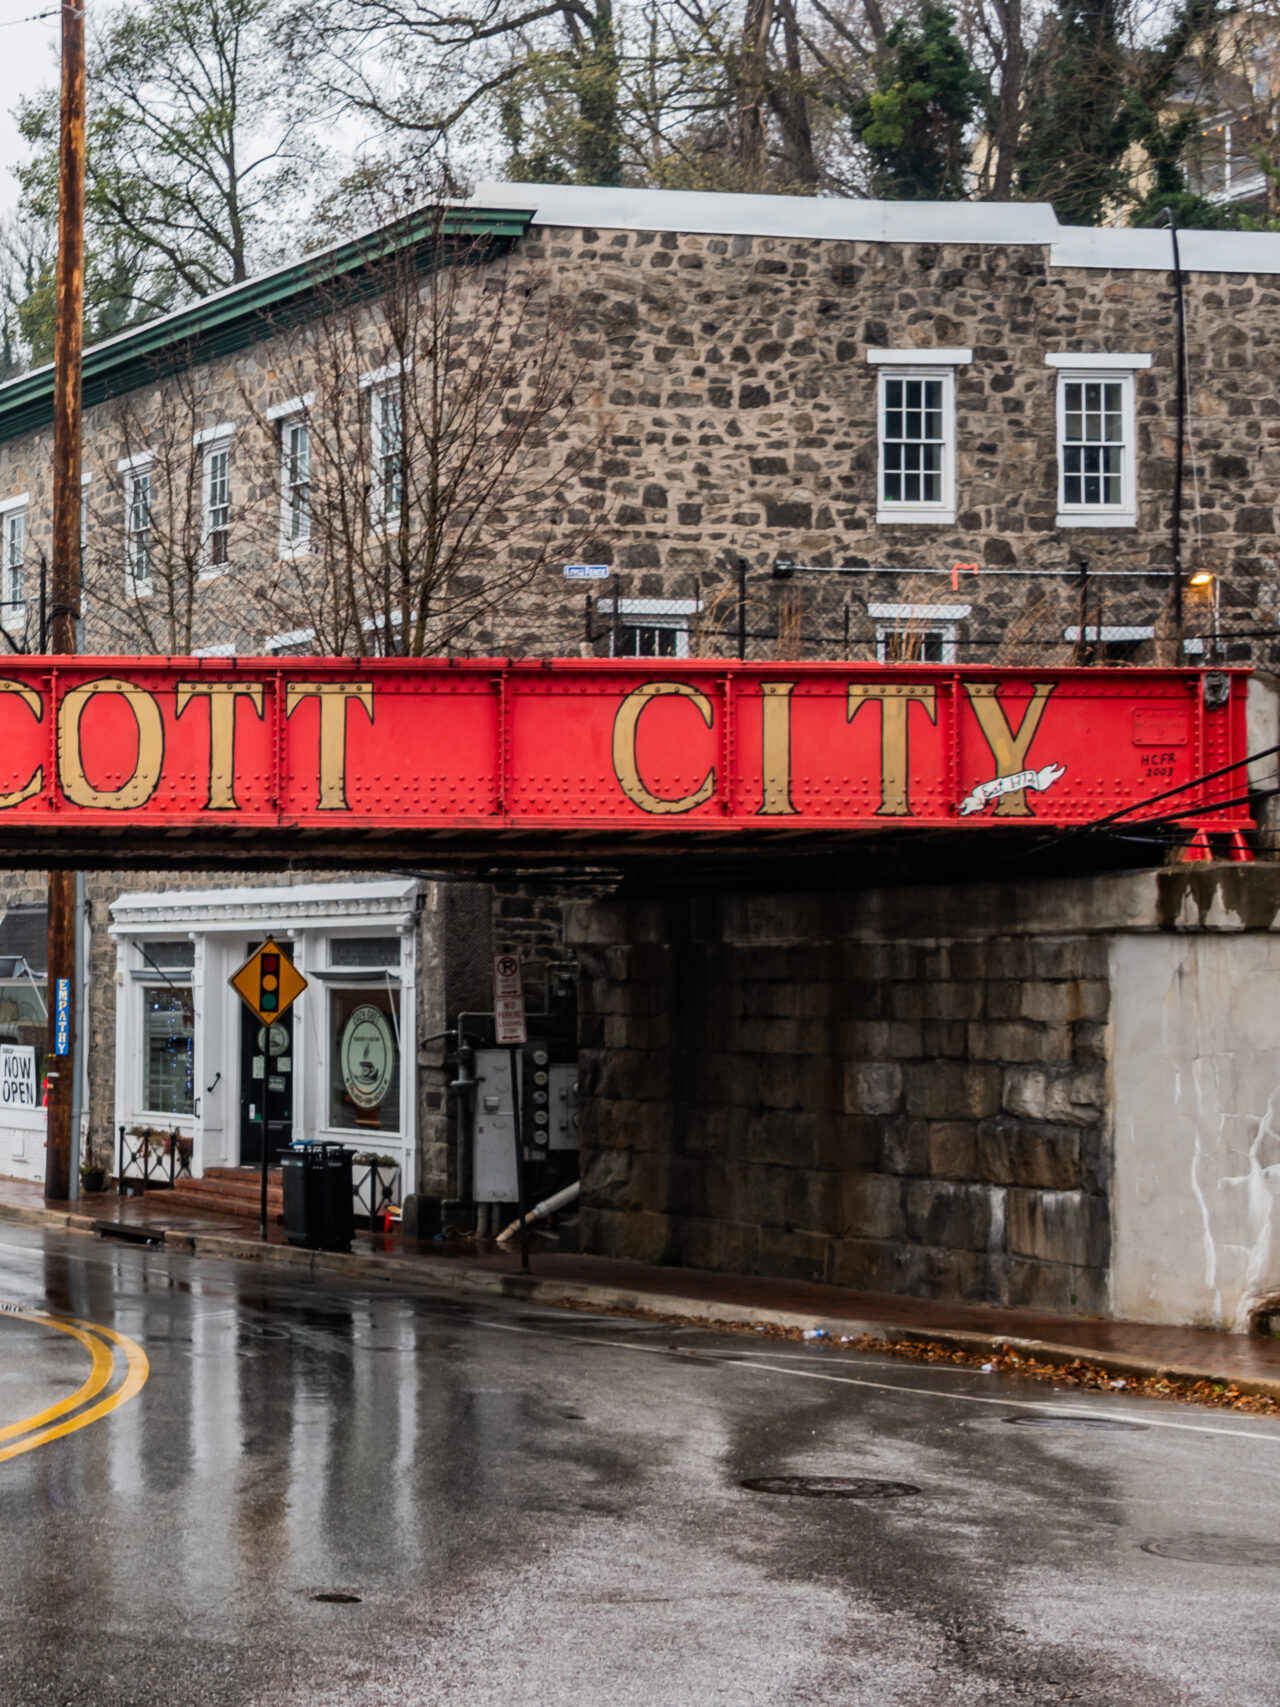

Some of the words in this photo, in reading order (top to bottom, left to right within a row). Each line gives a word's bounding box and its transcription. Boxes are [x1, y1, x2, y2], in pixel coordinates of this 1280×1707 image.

[611, 680, 1059, 817] CITY
[1141, 752, 1176, 766] HCFR
[58, 979, 68, 1054] EMPATHY
[503, 1001, 516, 1010] NO
[4, 1056, 31, 1079] NOW
[2, 1080, 34, 1105] OPEN
